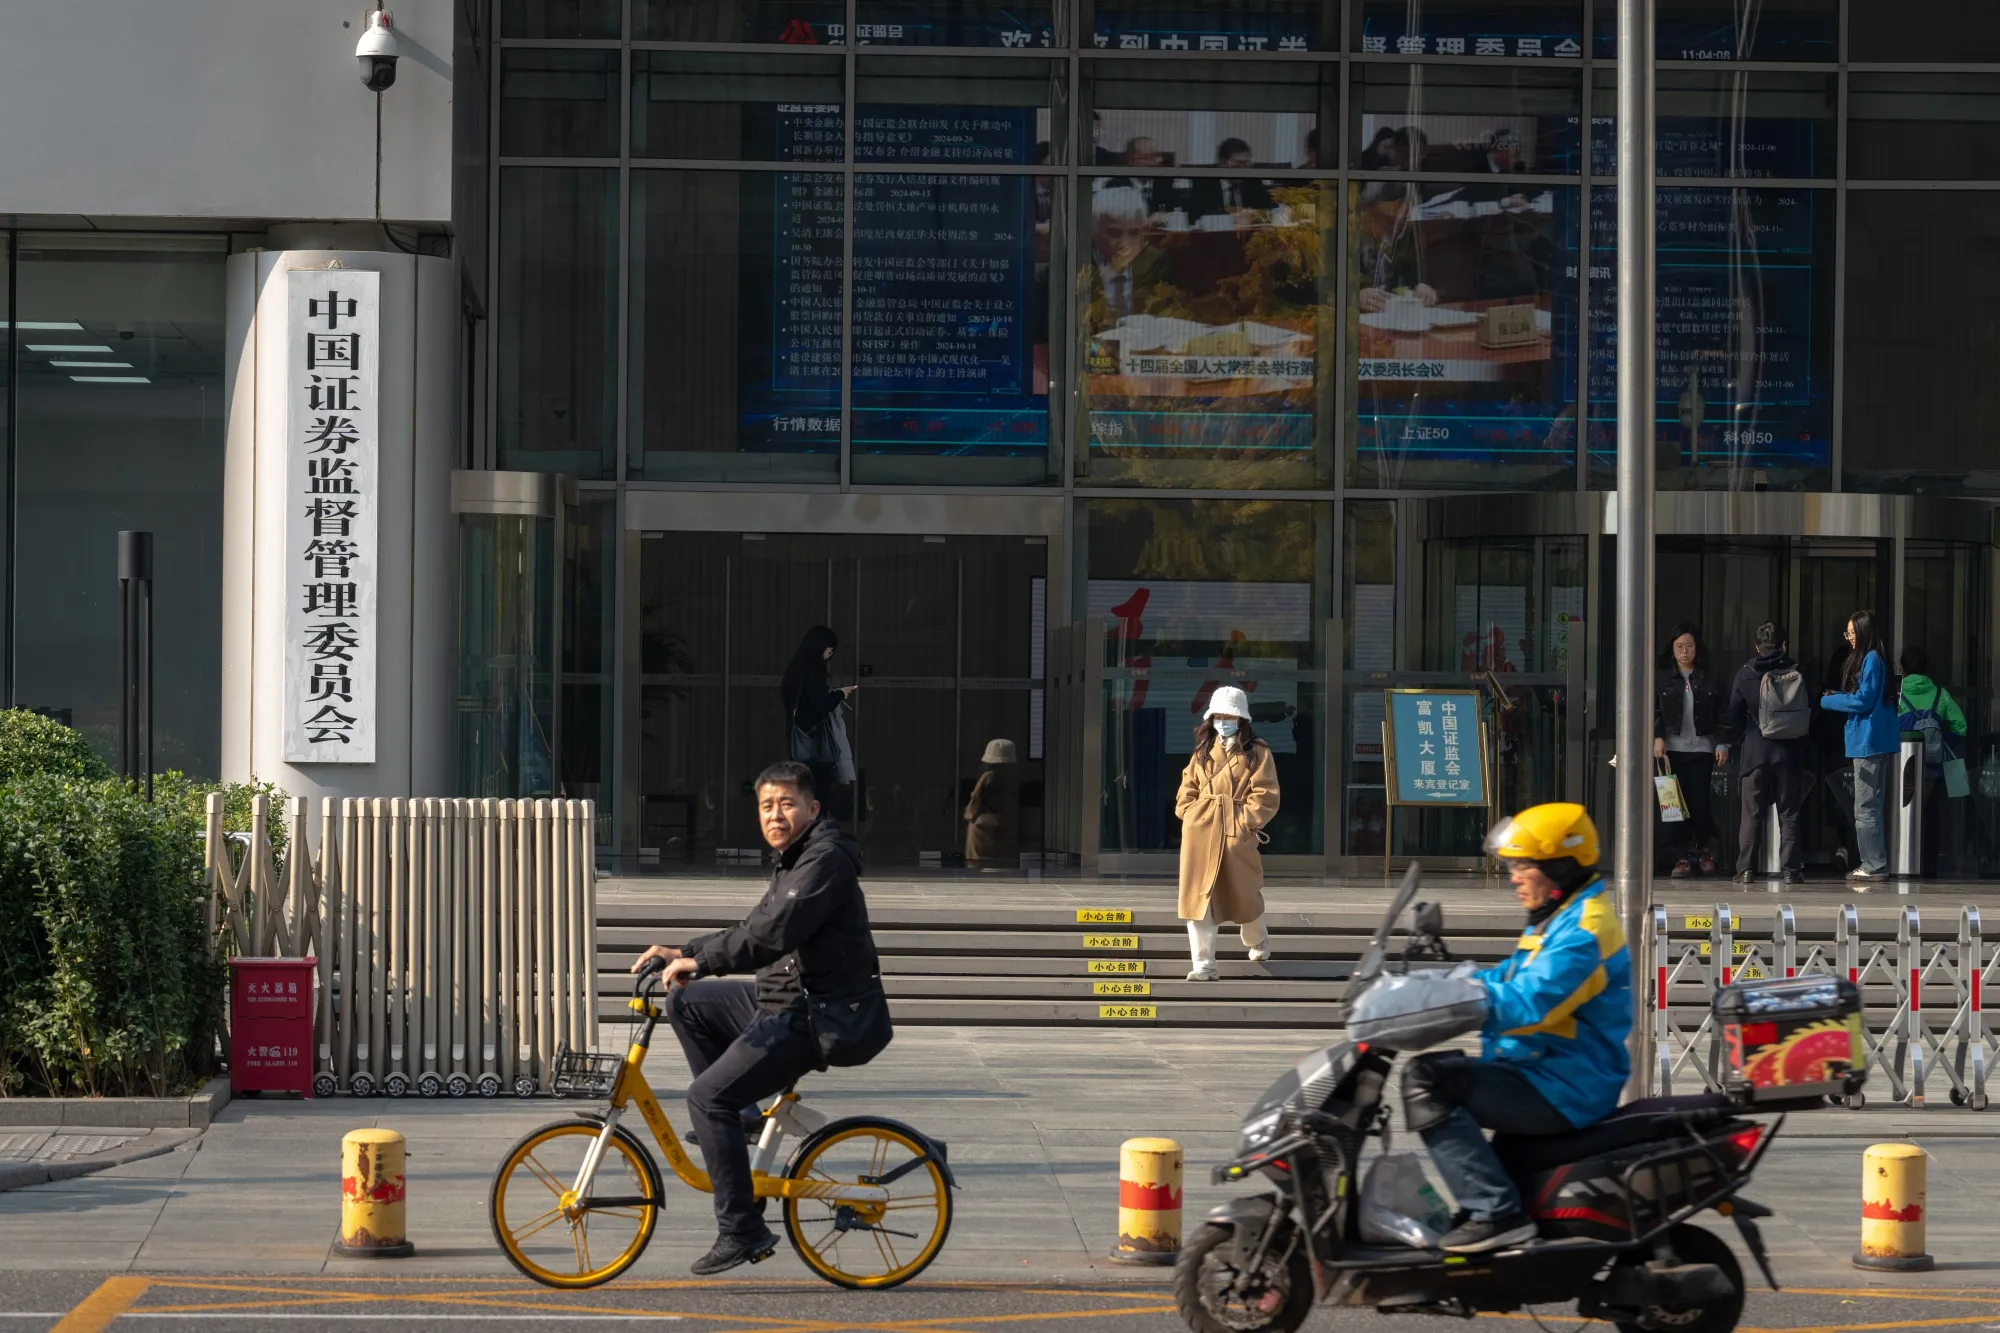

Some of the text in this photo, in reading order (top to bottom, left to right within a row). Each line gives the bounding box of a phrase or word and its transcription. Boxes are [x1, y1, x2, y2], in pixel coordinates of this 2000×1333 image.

[828, 24, 903, 38] 中证监会
[936, 342, 976, 350] 2024-10-18
[773, 416, 841, 431] 行情数据
[1400, 426, 1449, 440] 上证50
[1723, 431, 1772, 444] 科创50
[303, 290, 361, 744] 中国证券监督管理委员会
[1416, 700, 1436, 776] 富凯大厦
[1441, 700, 1461, 776] 中国证监会
[1413, 778, 1471, 790] 来宾登记室
[1083, 912, 1125, 921] 小心台阶
[1089, 937, 1132, 947] 小心台阶
[1094, 962, 1138, 972] 小心台阶
[247, 982, 297, 994] 灭火器箱
[1100, 984, 1144, 993] 小心台阶
[1106, 1007, 1150, 1017] 小心台阶
[283, 1046, 298, 1057] 119
